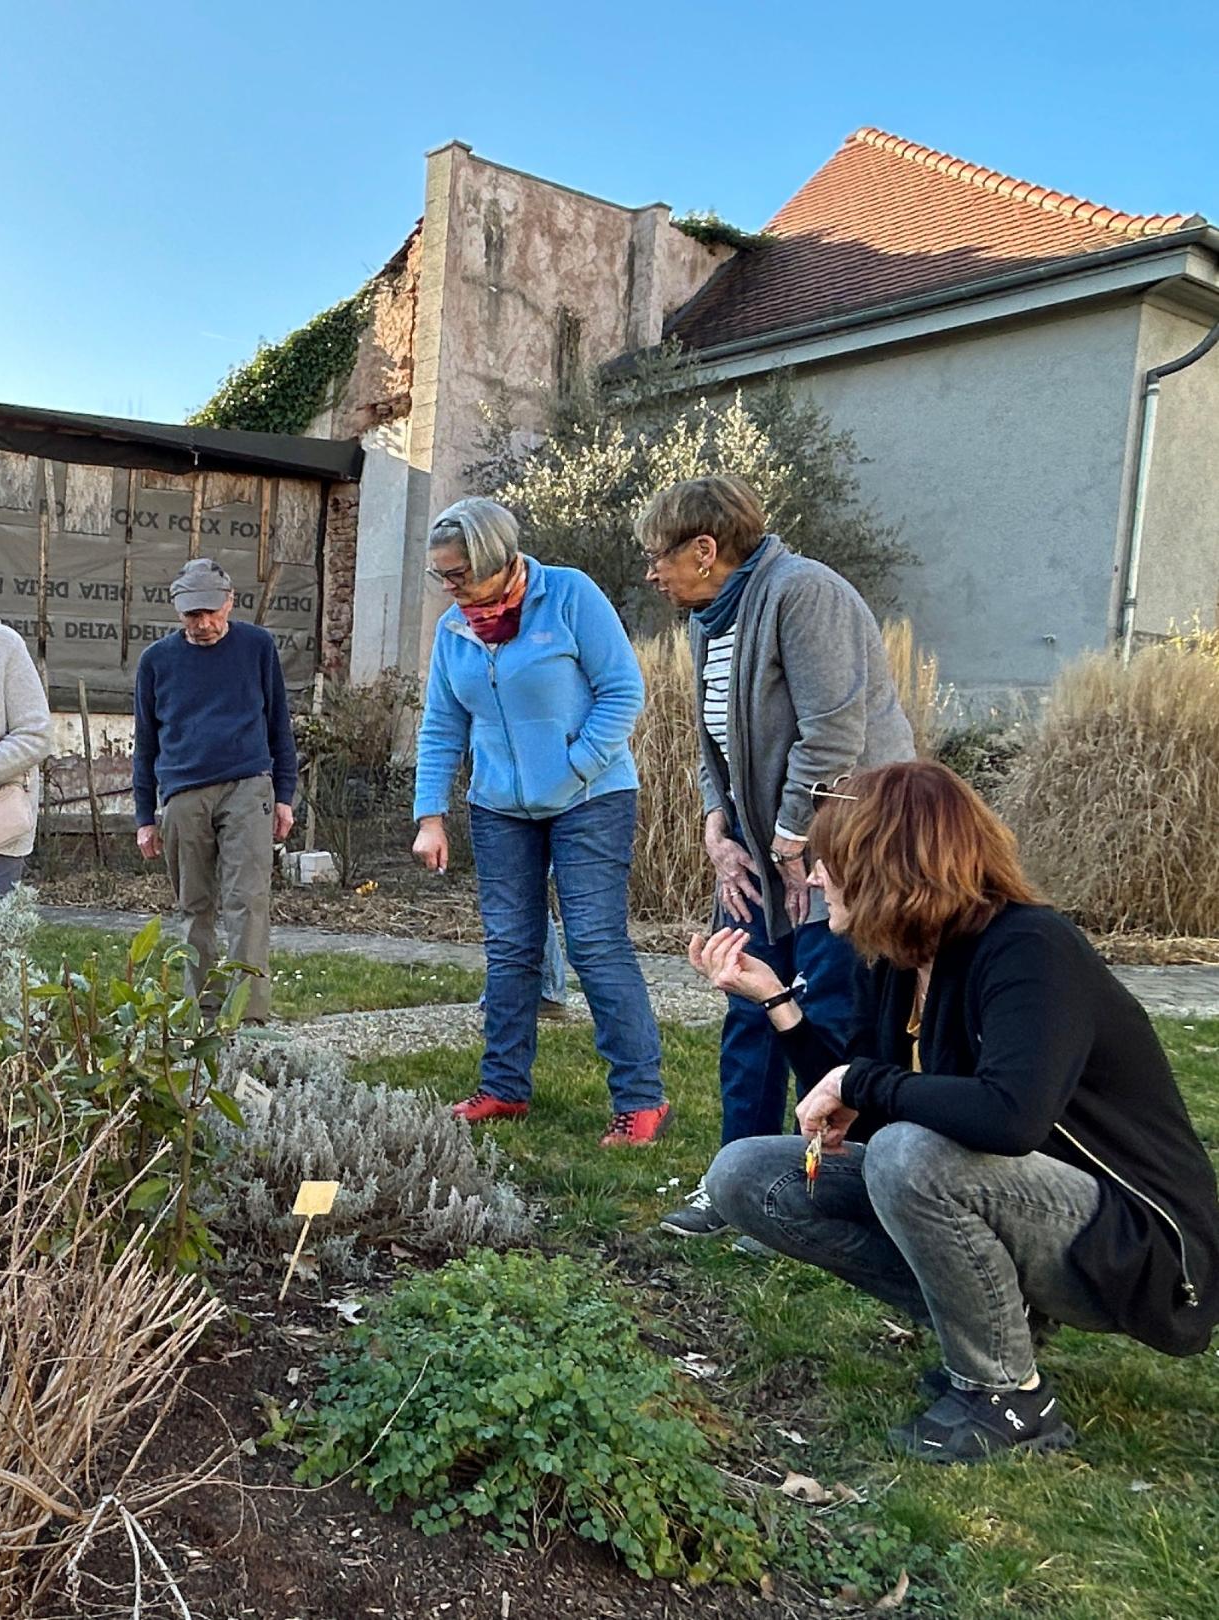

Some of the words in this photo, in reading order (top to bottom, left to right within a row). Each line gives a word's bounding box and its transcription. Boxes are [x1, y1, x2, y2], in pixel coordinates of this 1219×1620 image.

[110, 507, 159, 529] OXX
[13, 577, 69, 599] DETA
[64, 621, 119, 640] DELTA
